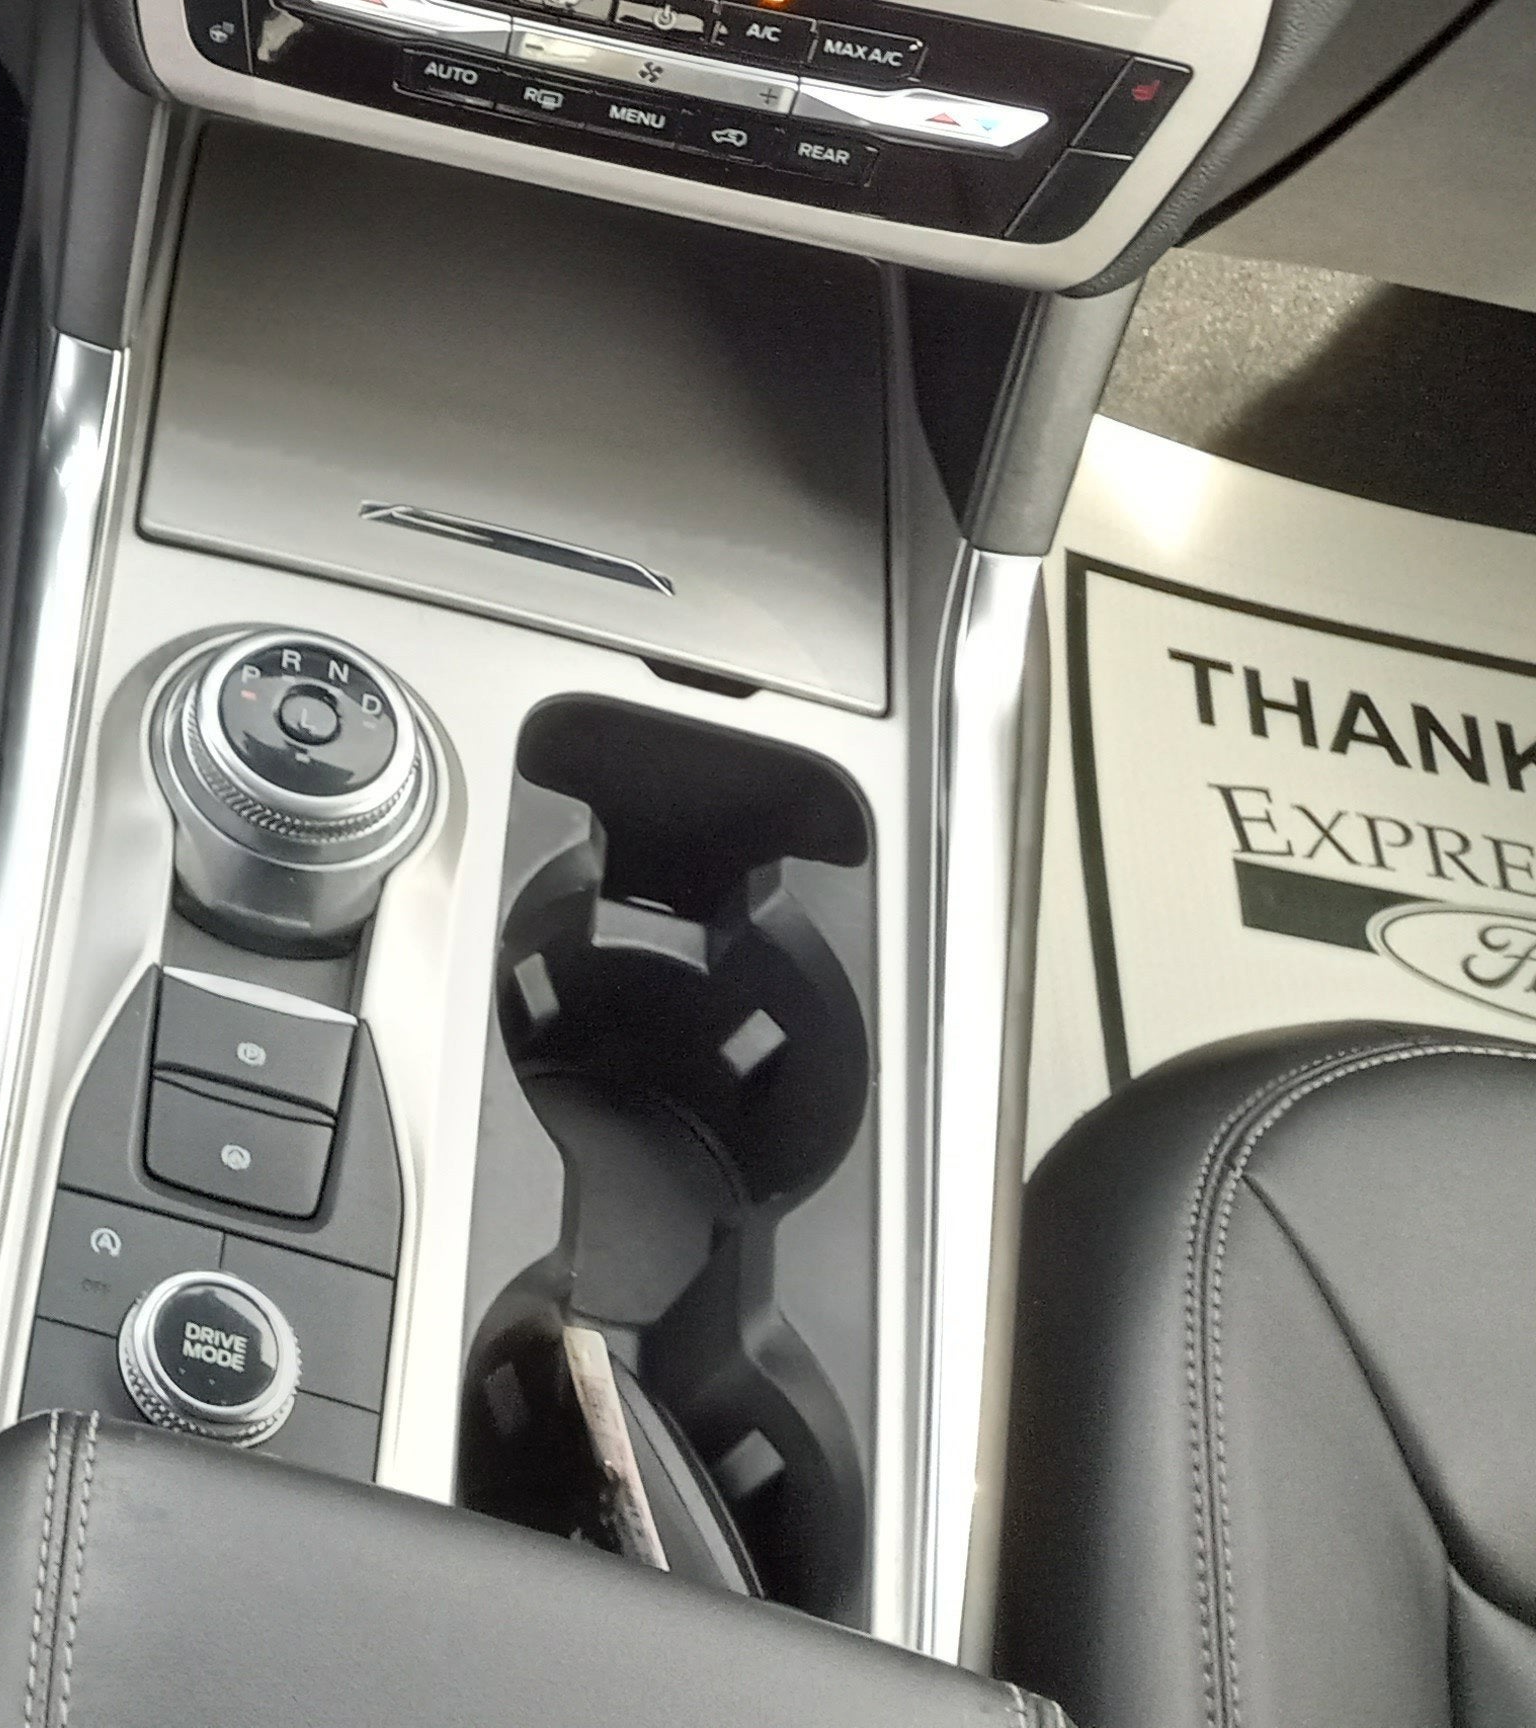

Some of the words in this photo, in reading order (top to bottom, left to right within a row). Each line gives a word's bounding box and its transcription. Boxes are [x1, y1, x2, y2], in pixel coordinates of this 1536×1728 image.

[746, 22, 782, 43] A/C
[823, 38, 869, 60] MAX
[869, 47, 904, 67] A/C
[424, 61, 478, 85] AUTO
[609, 104, 666, 129] MENU
[797, 142, 851, 166] REAR
[240, 664, 262, 684] P
[281, 648, 302, 672] R
[327, 659, 350, 684] N
[361, 694, 384, 716] D
[1167, 647, 1536, 792] THANK
[184, 1321, 248, 1355] DRIVE
[182, 1340, 246, 1373] MODE
